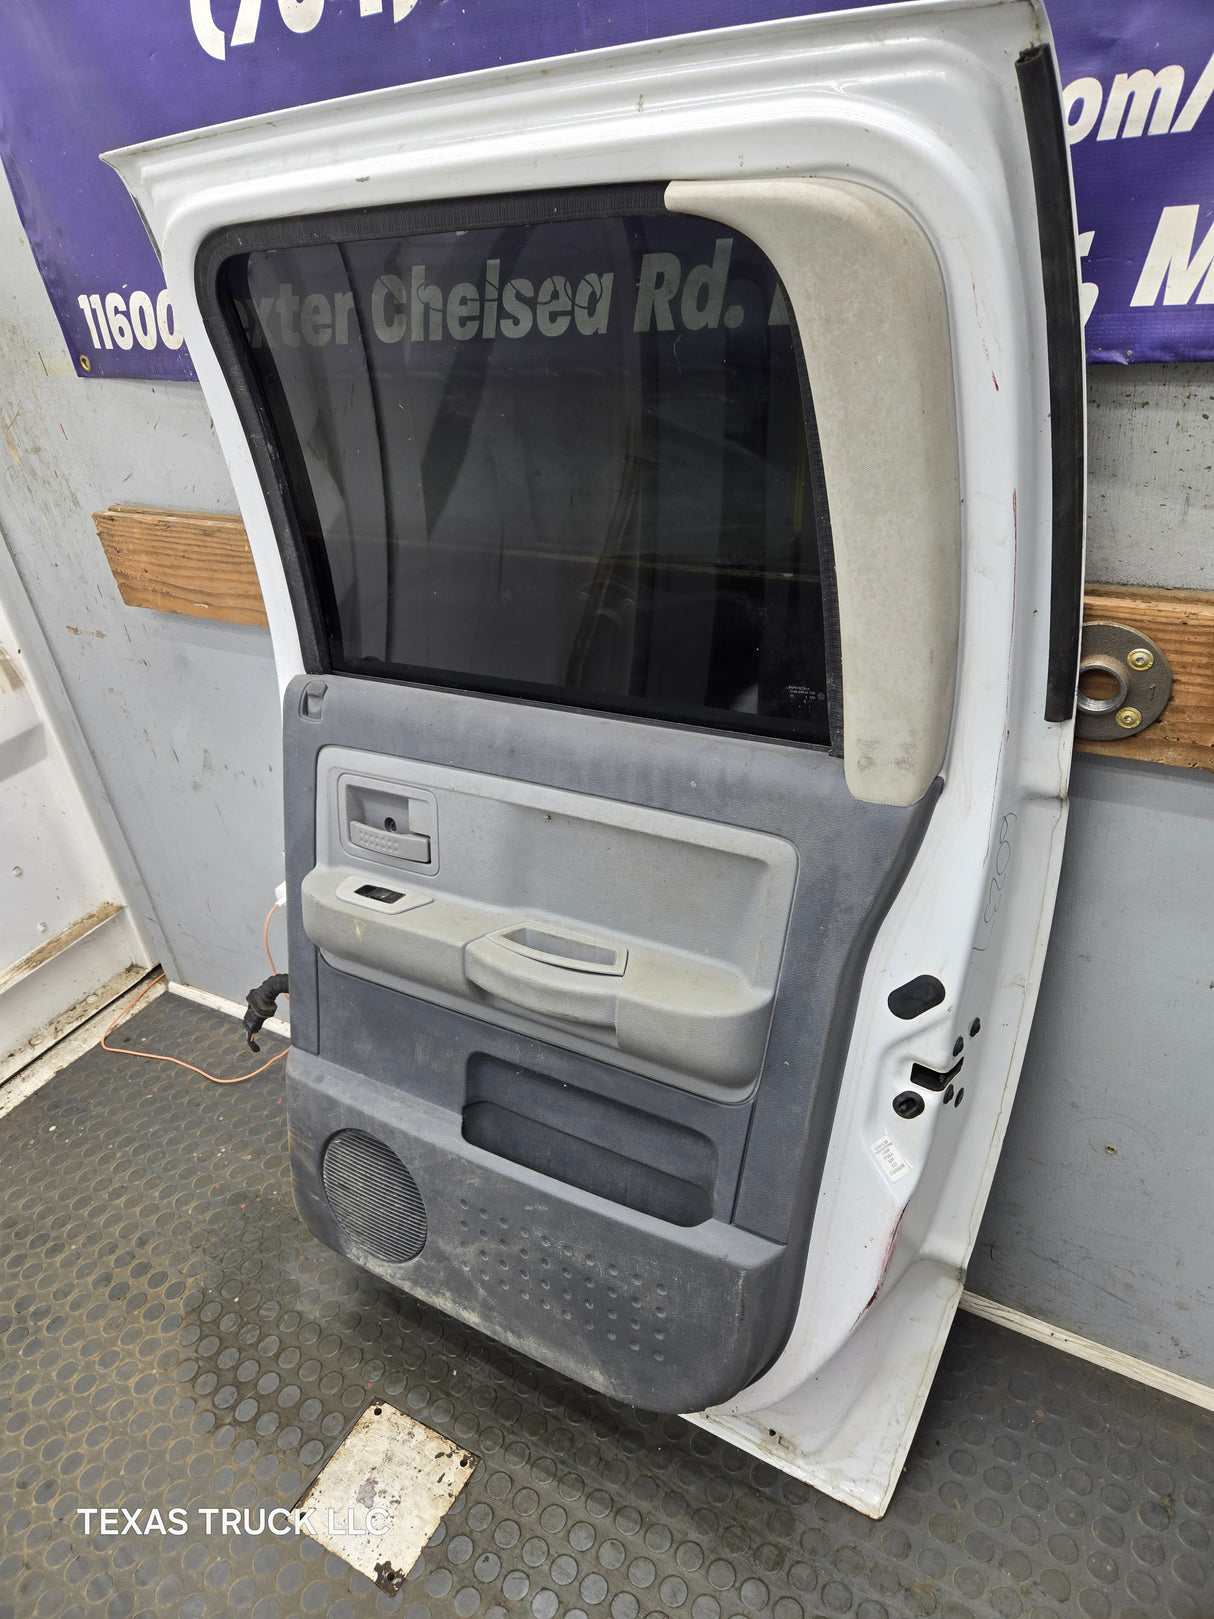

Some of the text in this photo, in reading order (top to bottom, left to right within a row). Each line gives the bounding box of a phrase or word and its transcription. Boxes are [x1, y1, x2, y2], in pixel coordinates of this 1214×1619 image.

[77, 288, 184, 351] 11600
[371, 259, 614, 345] Chelsea
[633, 238, 745, 333] Rd.
